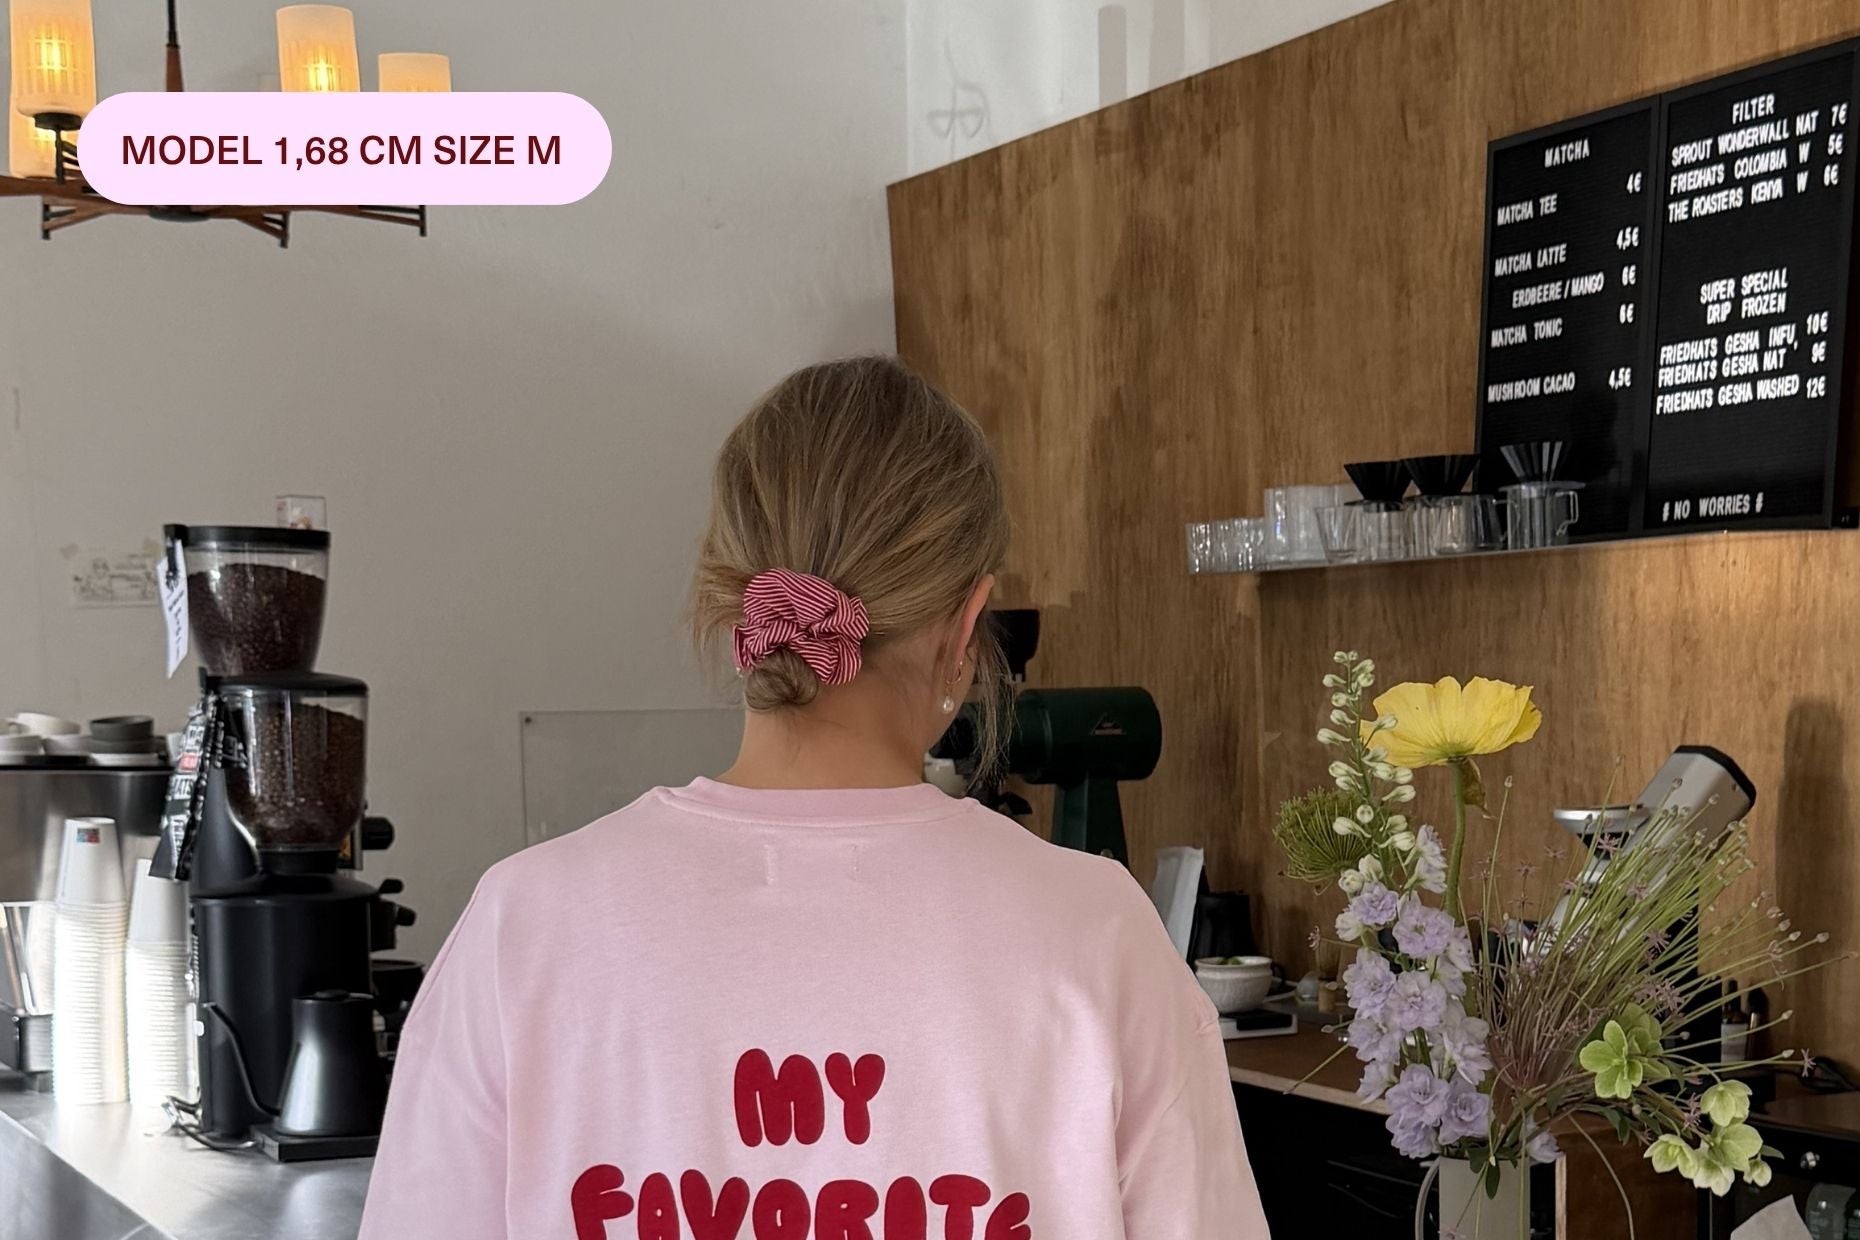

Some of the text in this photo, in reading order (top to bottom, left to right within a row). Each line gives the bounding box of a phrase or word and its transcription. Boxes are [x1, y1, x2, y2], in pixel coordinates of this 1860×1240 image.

[1733, 94, 1774, 124] FILTER
[1545, 139, 1589, 167] MATCHA
[1672, 103, 1847, 167] SPROUT WONDERWALL NAT 7€
[1670, 134, 1843, 195] FRIEDHATS COLOMBIA W 5€
[1498, 172, 1641, 225] MATCHA TEE 4€
[1668, 199, 1689, 223] THE
[1692, 187, 1743, 217] ROASTERS
[1751, 178, 1783, 204] KENYA
[1797, 171, 1808, 193] W
[1495, 227, 1638, 276] MATCHA LATTE 4,5€
[1700, 267, 1788, 306] SUPER SPECIAL
[1707, 292, 1786, 324] DRIP FROZEN
[1491, 325, 1527, 347] MATCHA
[1534, 318, 1562, 340] TONIC
[1660, 337, 1718, 366] FRIEDHATS
[1725, 330, 1760, 355] GESHA
[1807, 311, 1828, 335] 10€
[1544, 372, 1575, 394] CACAO
[1609, 367, 1631, 390] 4,5€
[1658, 341, 1826, 388] FRIEDHATS GESHA NAT 9€
[1656, 374, 1826, 415] FRIEDHATS GESHA WASHED 12€
[1674, 500, 1690, 519] NO
[1700, 495, 1750, 516] WORRIES
[733, 1049, 884, 1147] MY
